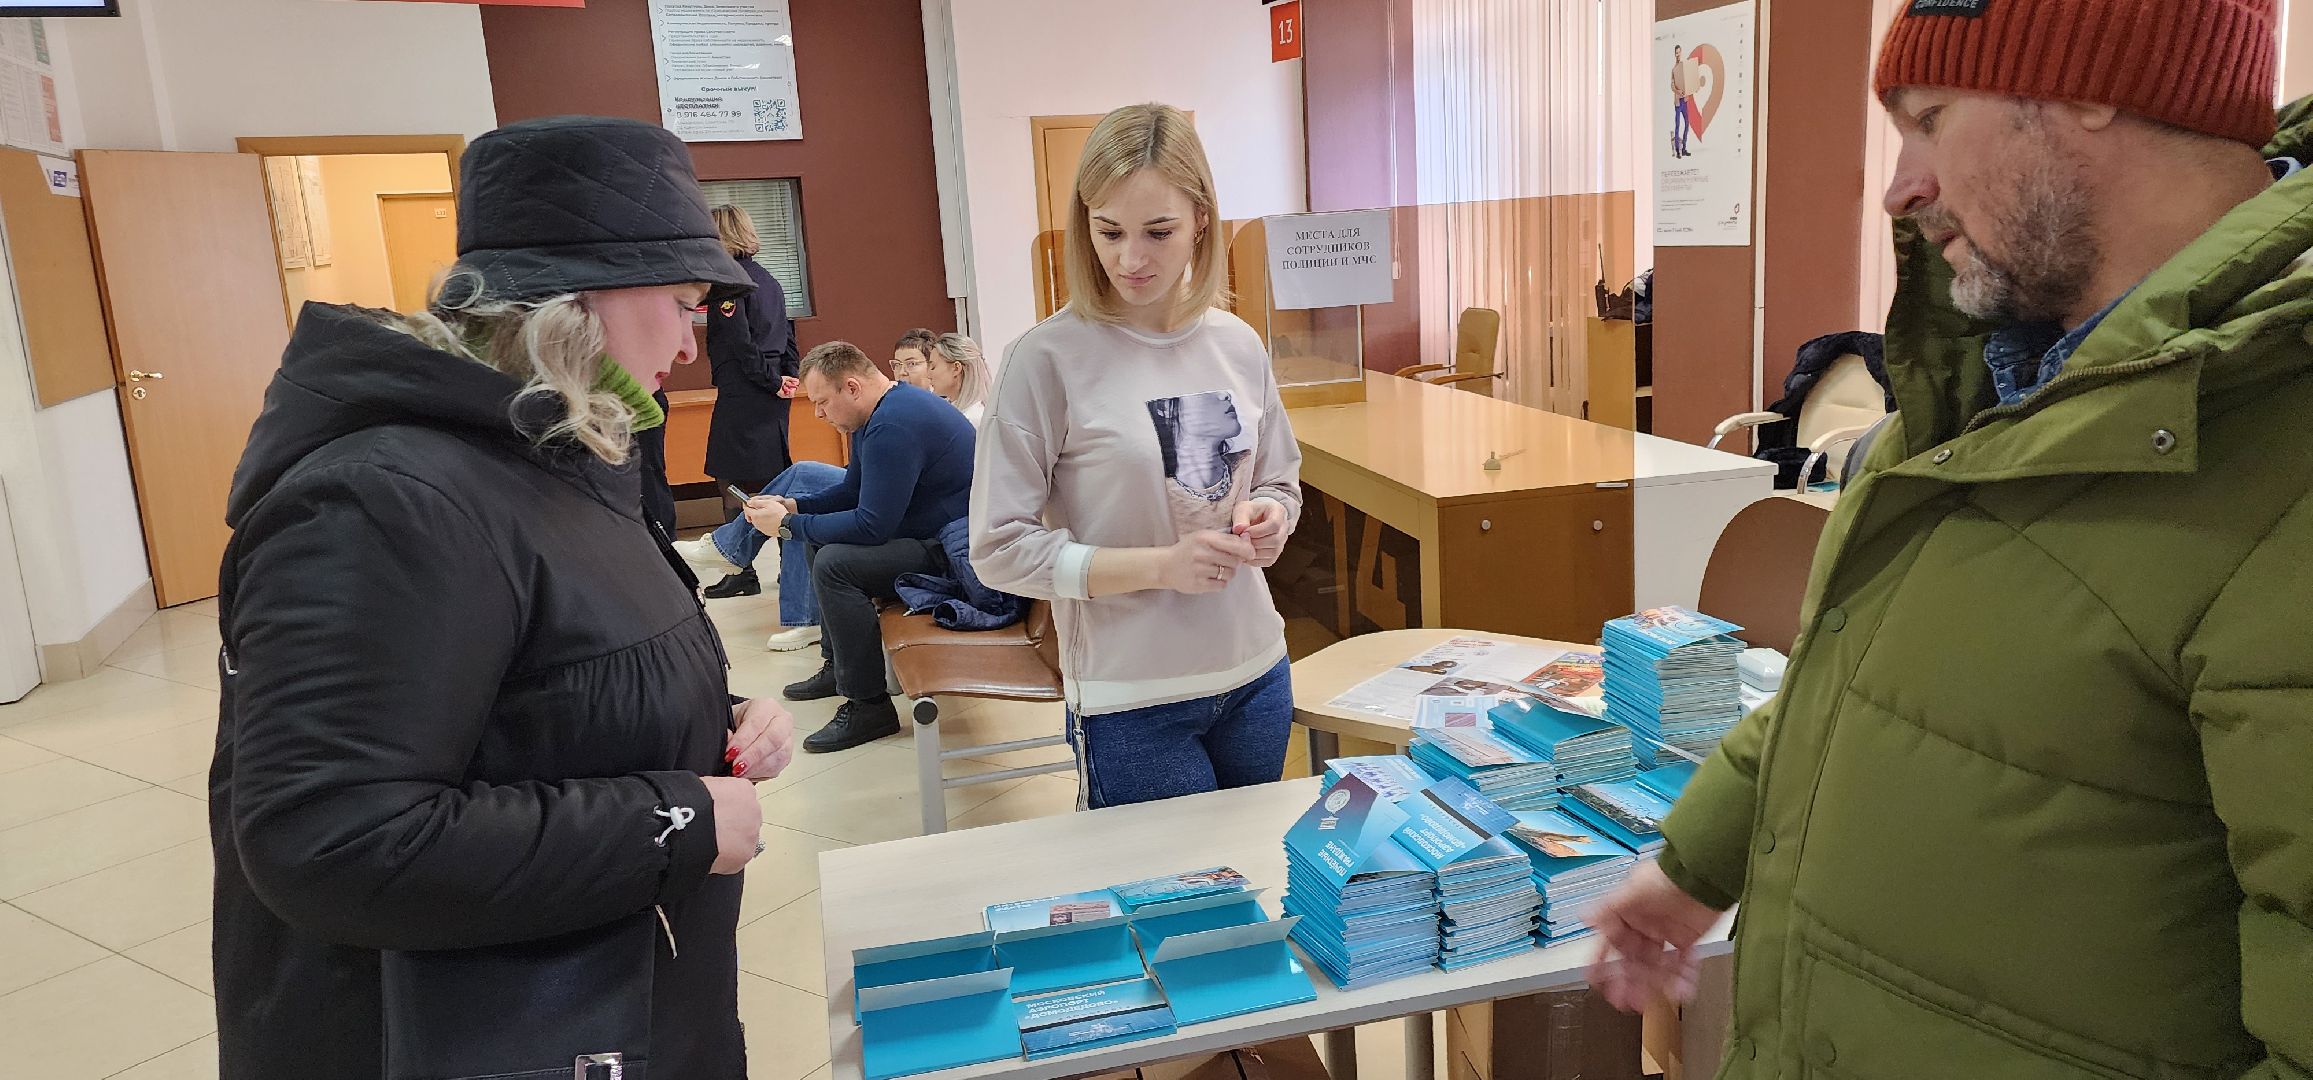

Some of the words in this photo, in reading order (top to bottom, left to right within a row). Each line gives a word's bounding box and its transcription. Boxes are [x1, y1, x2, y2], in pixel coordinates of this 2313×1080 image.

[1278, 18, 1293, 45] 13
[1295, 229, 1334, 241] МЕСТА
[1337, 227, 1361, 240] ДЛЯ
[1286, 241, 1371, 255] СОТРУДНИКОВ
[1282, 257, 1338, 270] ПОЛИЦИИ
[1341, 257, 1350, 266] И
[1352, 254, 1377, 267] МЧС
[1323, 492, 1407, 637] 14
[1400, 825, 1445, 860] МОСКОВСКИЙ
[1418, 826, 1454, 854] АЭРОПОРТ
[1317, 848, 1347, 877] ПОЧЁТНЫЕ
[1323, 839, 1354, 868] ГРАЖДАНЕ
[1024, 999, 1119, 1020] «ДОМОДЕДОВО»
[1025, 990, 1106, 1008] МОСКОВСКИЙ
[1027, 998, 1089, 1014] АЭРОПОРТ
